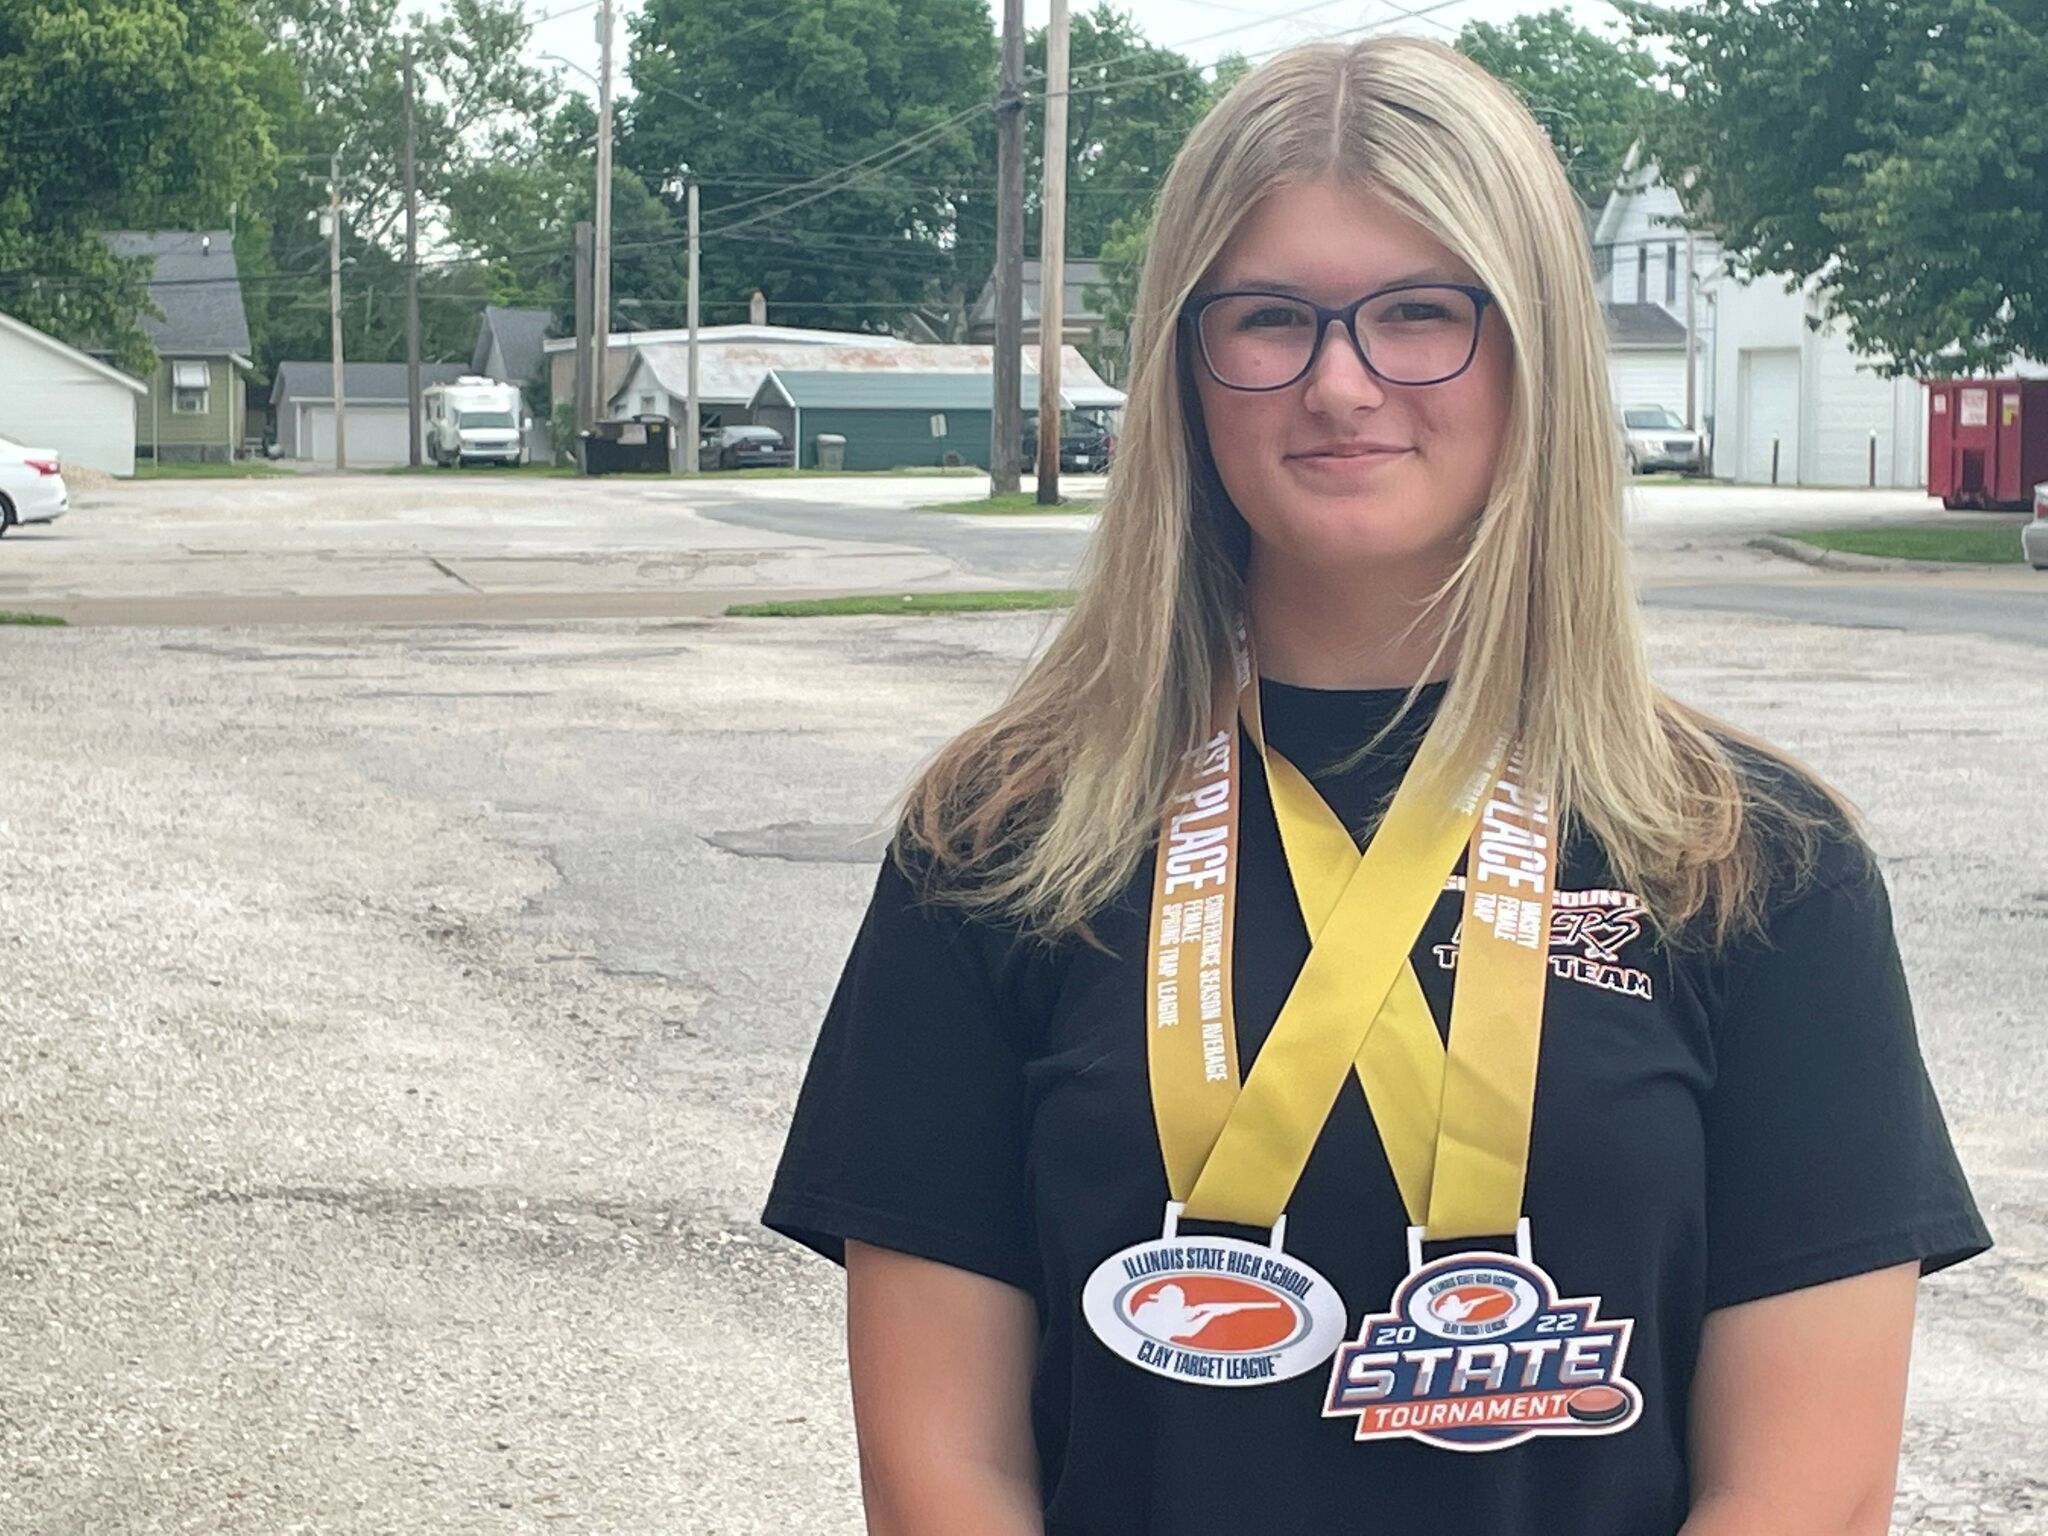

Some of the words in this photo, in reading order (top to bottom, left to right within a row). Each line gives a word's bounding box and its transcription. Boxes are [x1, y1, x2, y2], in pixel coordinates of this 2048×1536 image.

[1164, 778, 1230, 895] PLACE
[1477, 780, 1549, 894] PLACE
[1181, 899, 1204, 944] FEMALE
[1472, 892, 1497, 923] TRAP
[1494, 895, 1520, 941] FEMALE
[1552, 888, 1649, 911] OUNT
[1159, 902, 1183, 947] SPRING
[1200, 894, 1225, 968] CONFERENCE
[1157, 947, 1179, 977] TRAP
[1549, 955, 1653, 1000] TEAM
[1157, 979, 1179, 1028] LEAGUE
[1200, 969, 1222, 1020] SEASON
[1202, 1022, 1228, 1083] AVERAGE
[1122, 1248, 1184, 1280] ILLINOIS
[1186, 1247, 1226, 1272] STATE
[1227, 1250, 1263, 1278] HIGH
[1261, 1259, 1315, 1300] SCHOOL
[1375, 1326, 1417, 1346] 20
[1536, 1312, 1578, 1333] 22
[1137, 1340, 1173, 1368] CLAY
[1173, 1351, 1225, 1380] TARGET
[1341, 1334, 1615, 1402] STATE
[1374, 1393, 1568, 1430] TOURNAMENT
